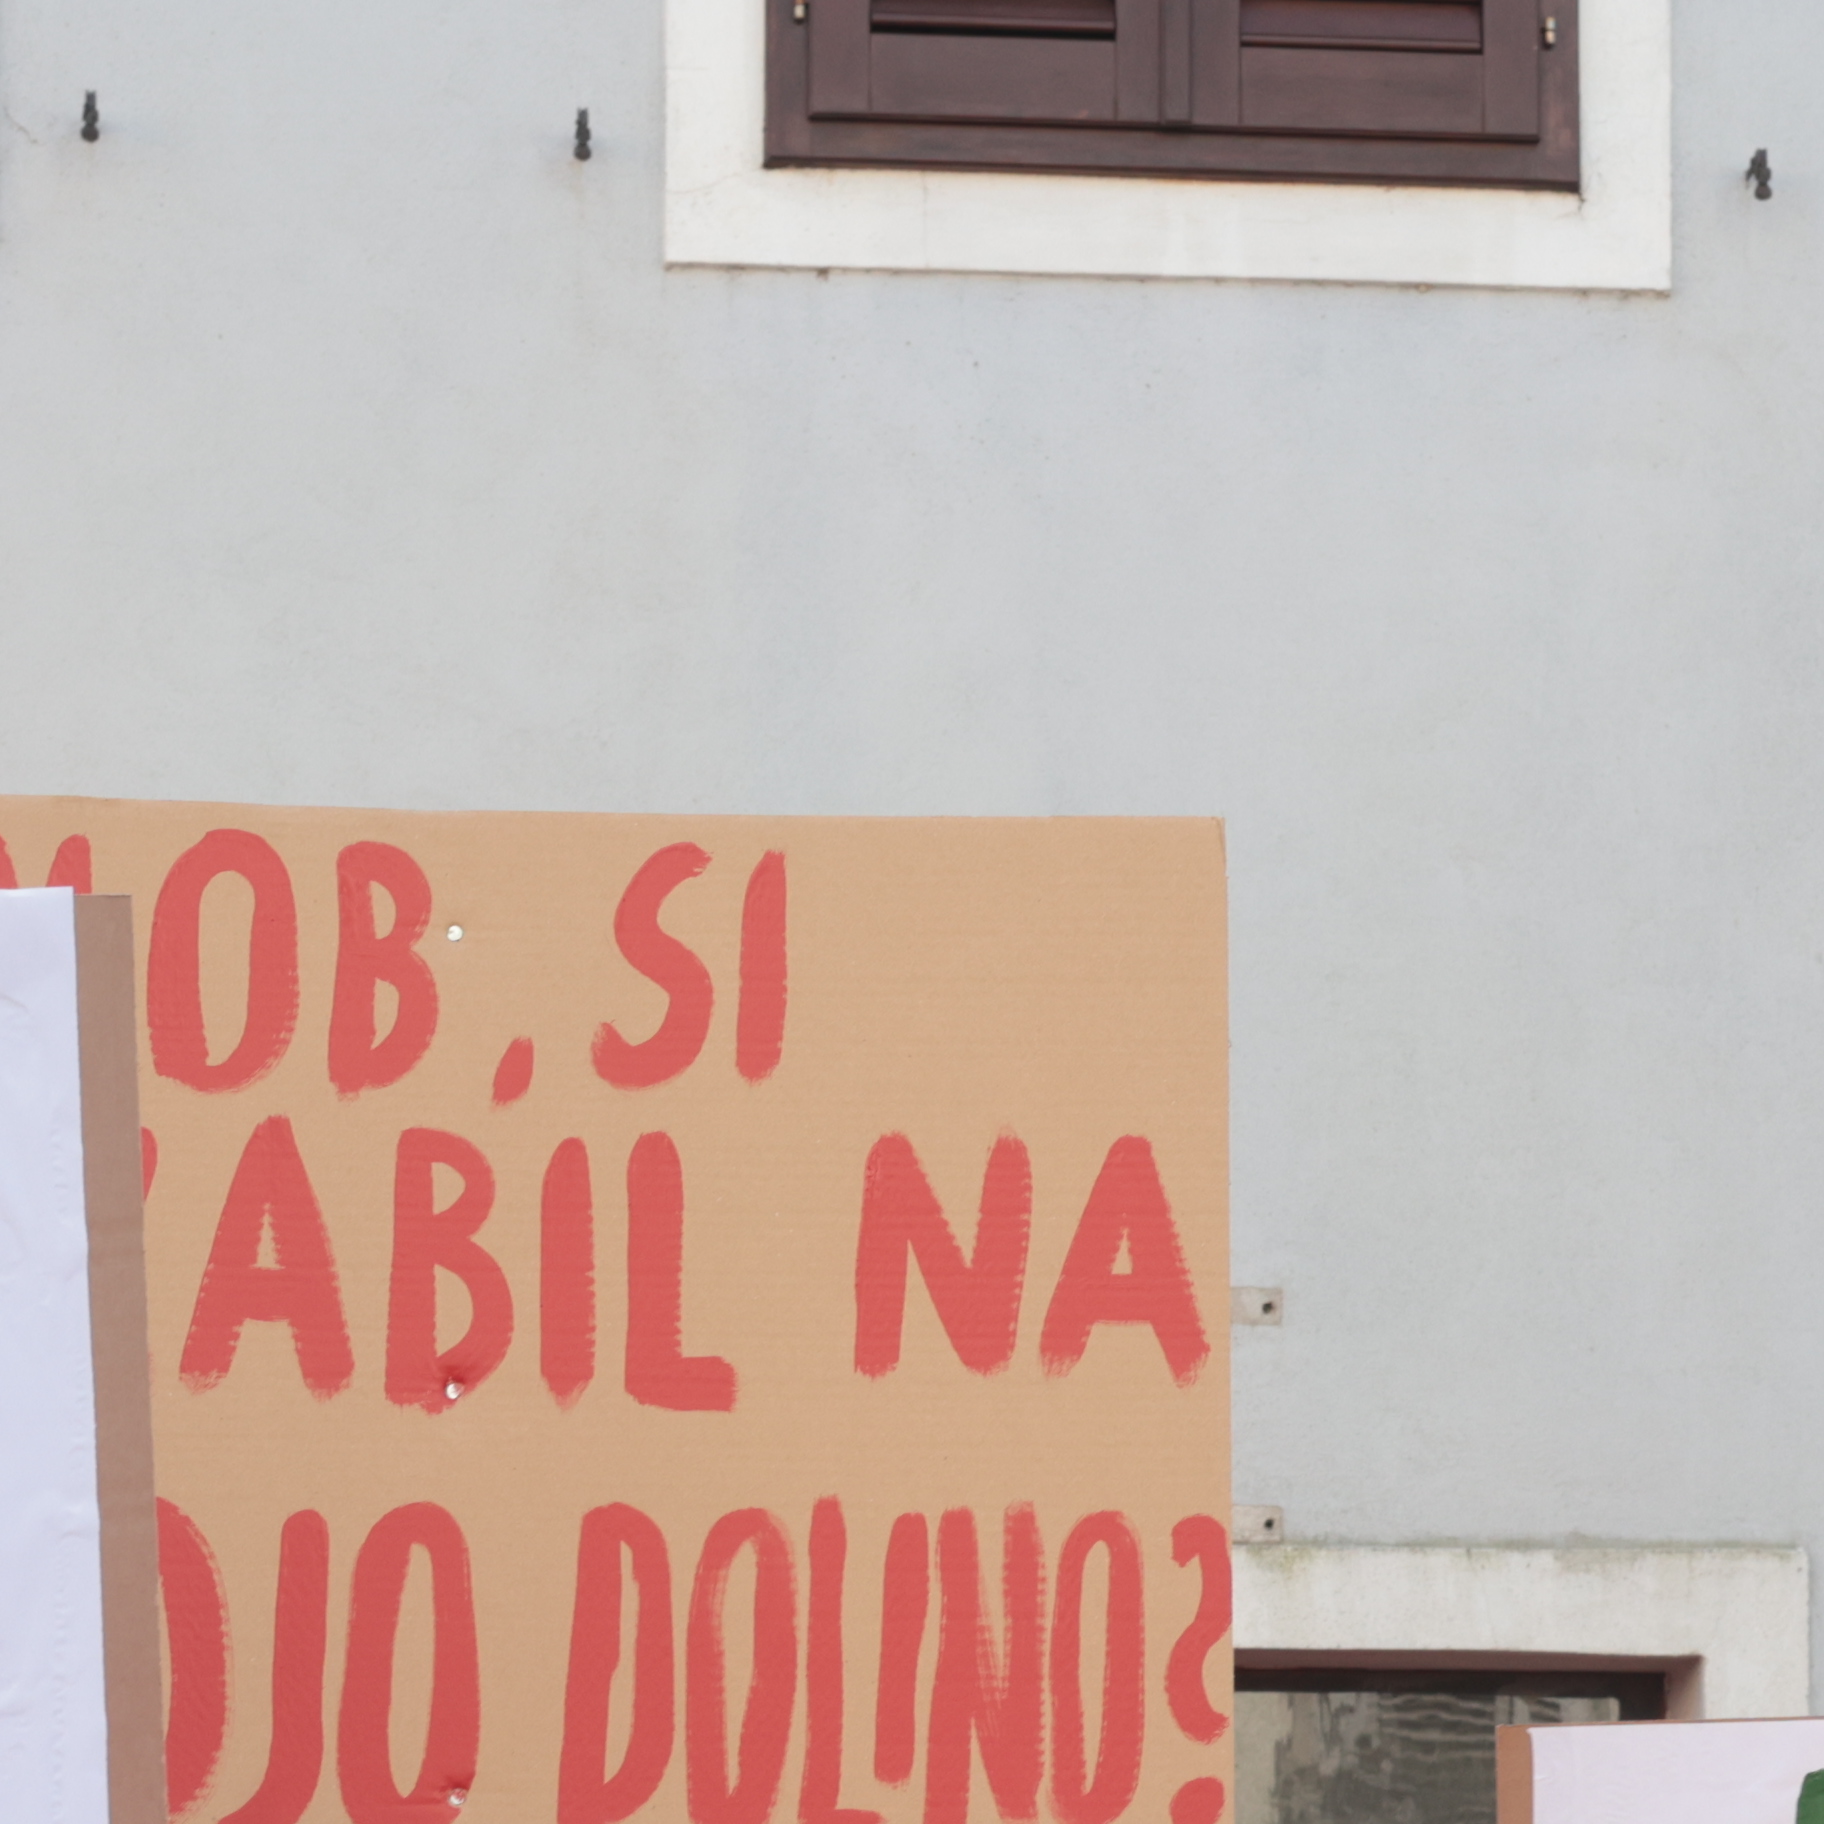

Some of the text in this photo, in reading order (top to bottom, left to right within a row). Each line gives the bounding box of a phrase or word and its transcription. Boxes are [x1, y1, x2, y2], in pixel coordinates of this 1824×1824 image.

[590, 841, 787, 1091] SI
[141, 1115, 1212, 1415] ABIL NA
